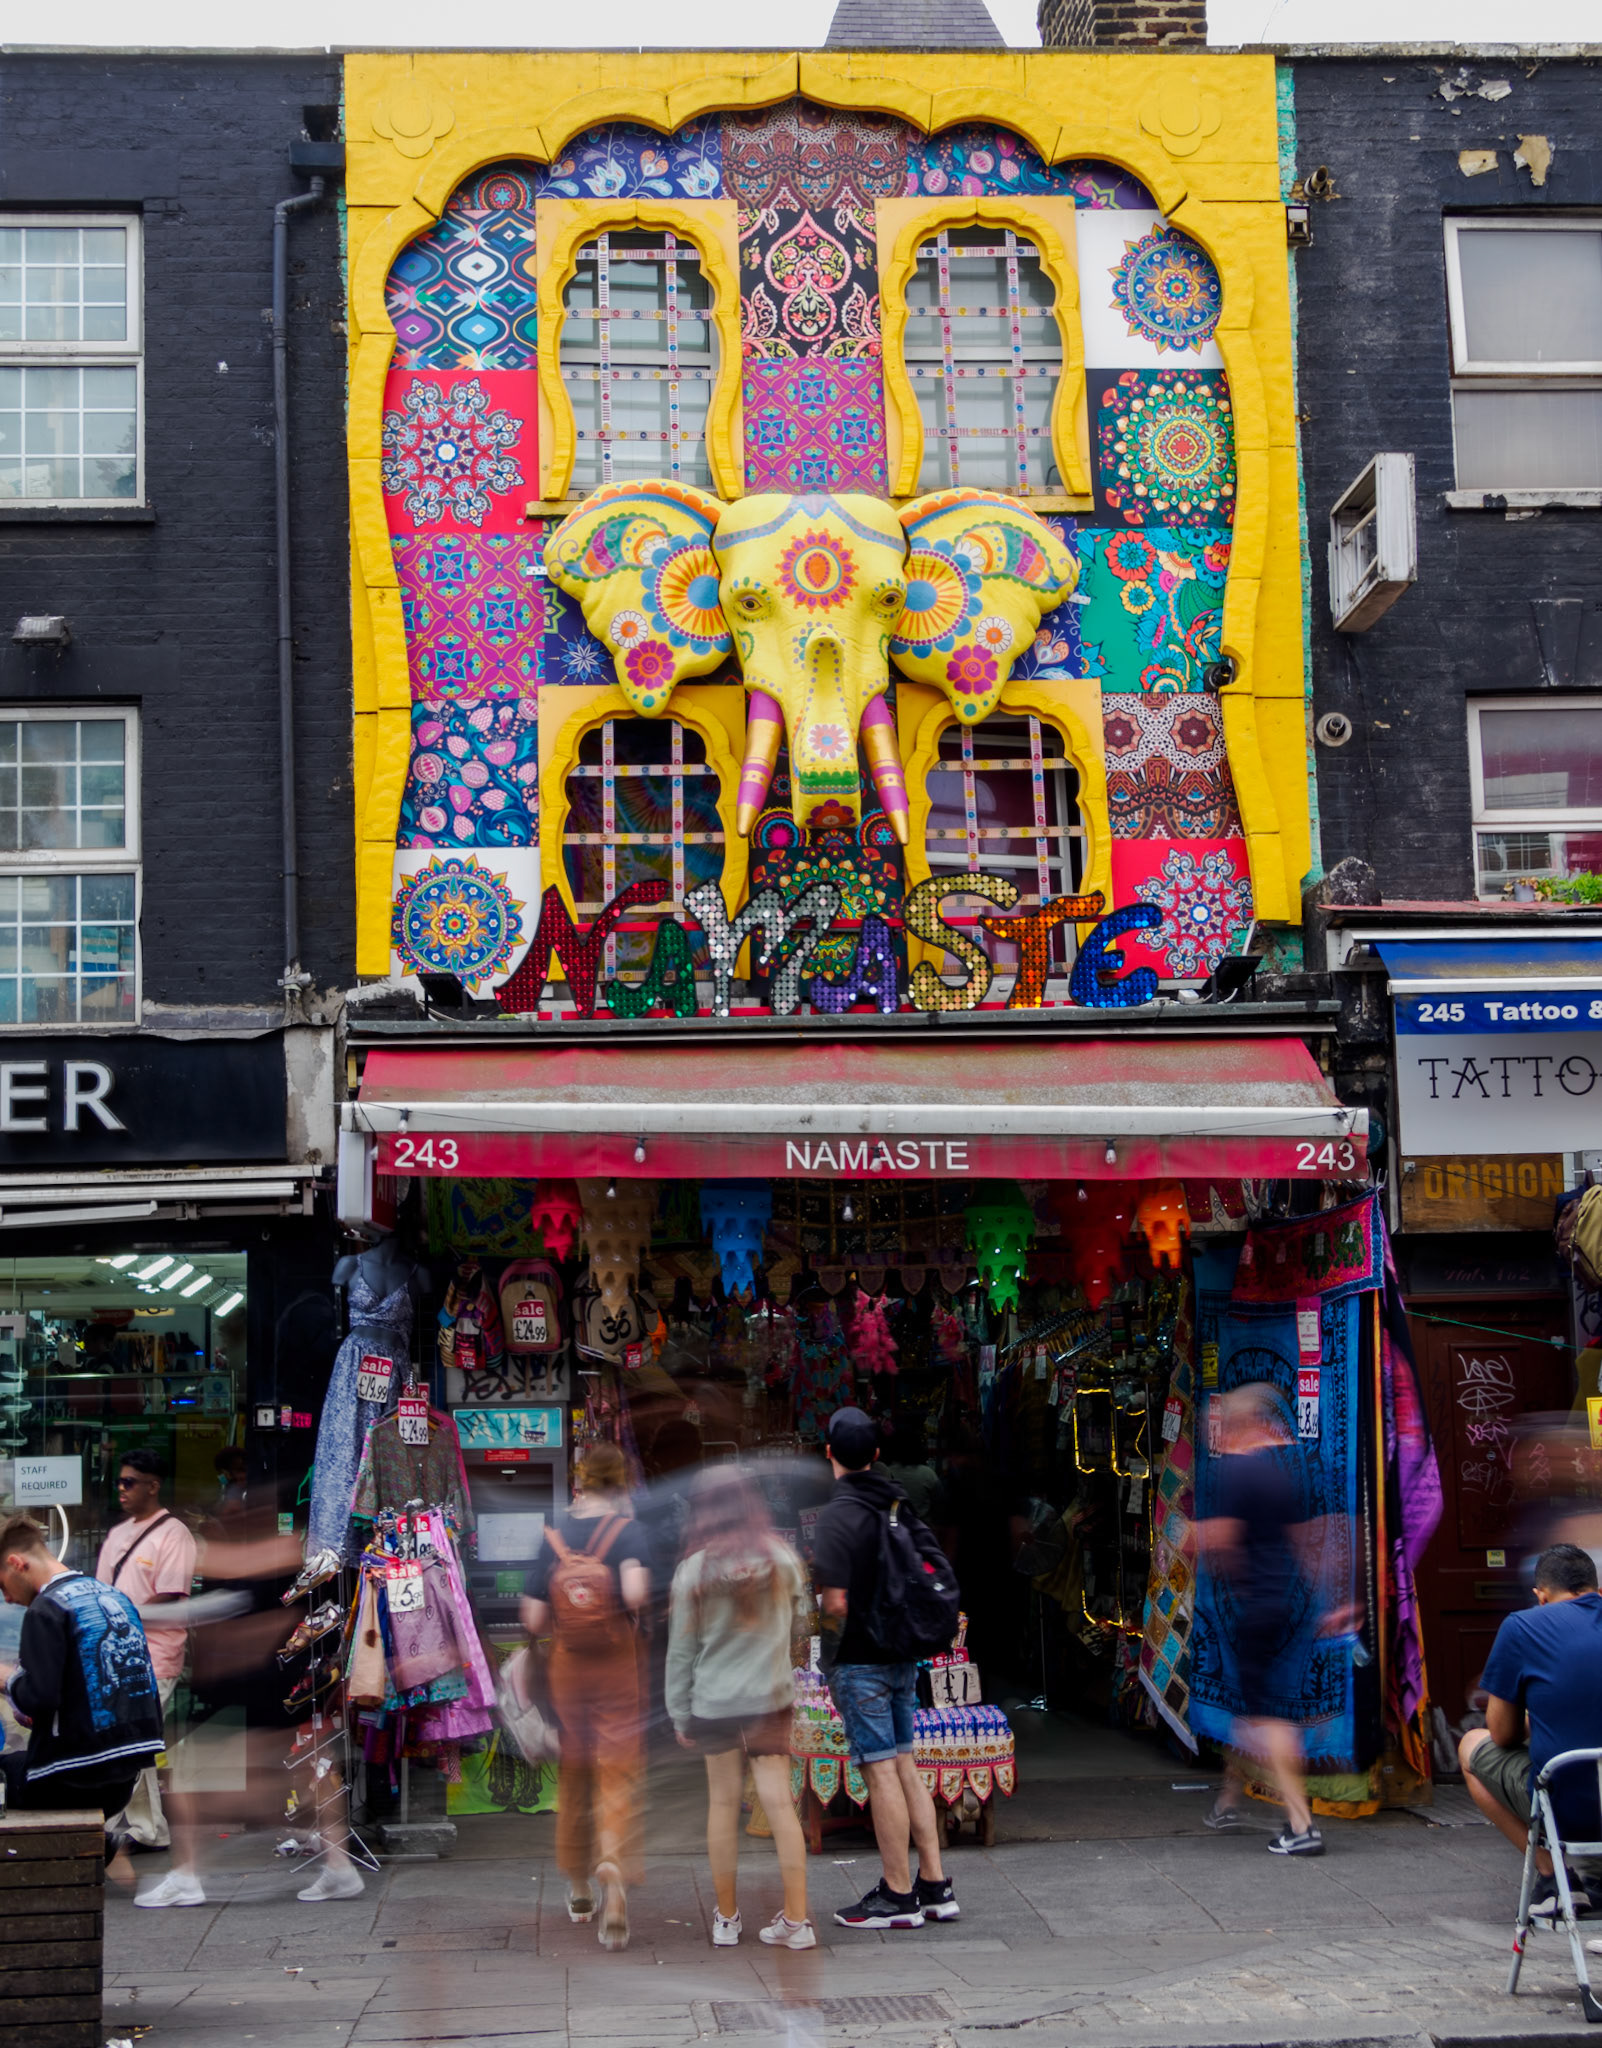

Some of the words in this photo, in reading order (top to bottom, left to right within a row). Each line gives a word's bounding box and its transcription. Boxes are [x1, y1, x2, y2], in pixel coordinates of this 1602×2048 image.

[492, 872, 1163, 1018] NAMASTE
[1418, 1003, 1465, 1022] 245
[1484, 1002, 1578, 1021] Tattoo
[1418, 1055, 1602, 1098] TATTO
[0, 1060, 127, 1130] ER
[394, 1138, 459, 1169] 243
[785, 1140, 970, 1171] NAMASTE
[1295, 1142, 1356, 1172] 243
[514, 1303, 544, 1316] sale
[361, 1361, 391, 1374] sale
[358, 1375, 388, 1401] £19.99
[1299, 1374, 1319, 1392] sale
[400, 1403, 427, 1415] sale
[467, 1412, 549, 1443] ATM
[21, 1465, 48, 1475] STAFF
[21, 1480, 68, 1491] REQUIRED
[400, 1517, 429, 1533] sle
[388, 1563, 419, 1579] sale
[935, 1649, 965, 1666] sale
